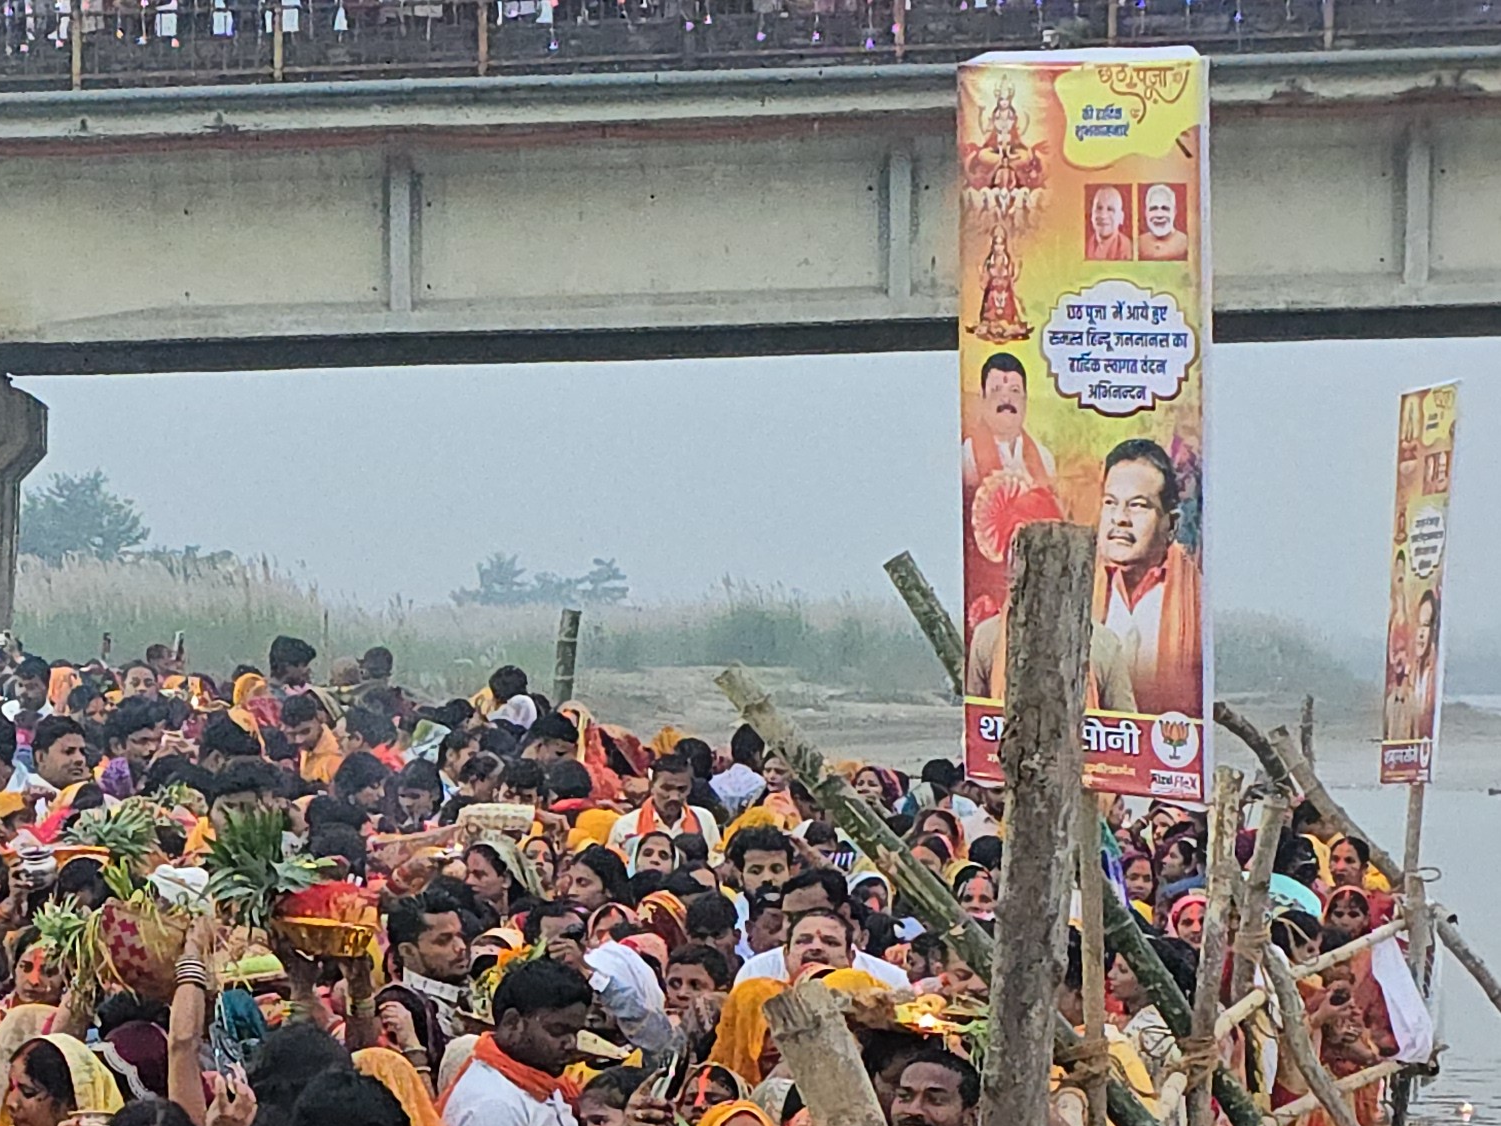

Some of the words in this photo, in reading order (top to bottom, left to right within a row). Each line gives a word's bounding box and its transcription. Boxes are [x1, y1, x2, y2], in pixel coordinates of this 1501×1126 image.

[1086, 304, 1107, 325] पूजा
[1111, 300, 1125, 321] में
[1171, 333, 1188, 348] का
